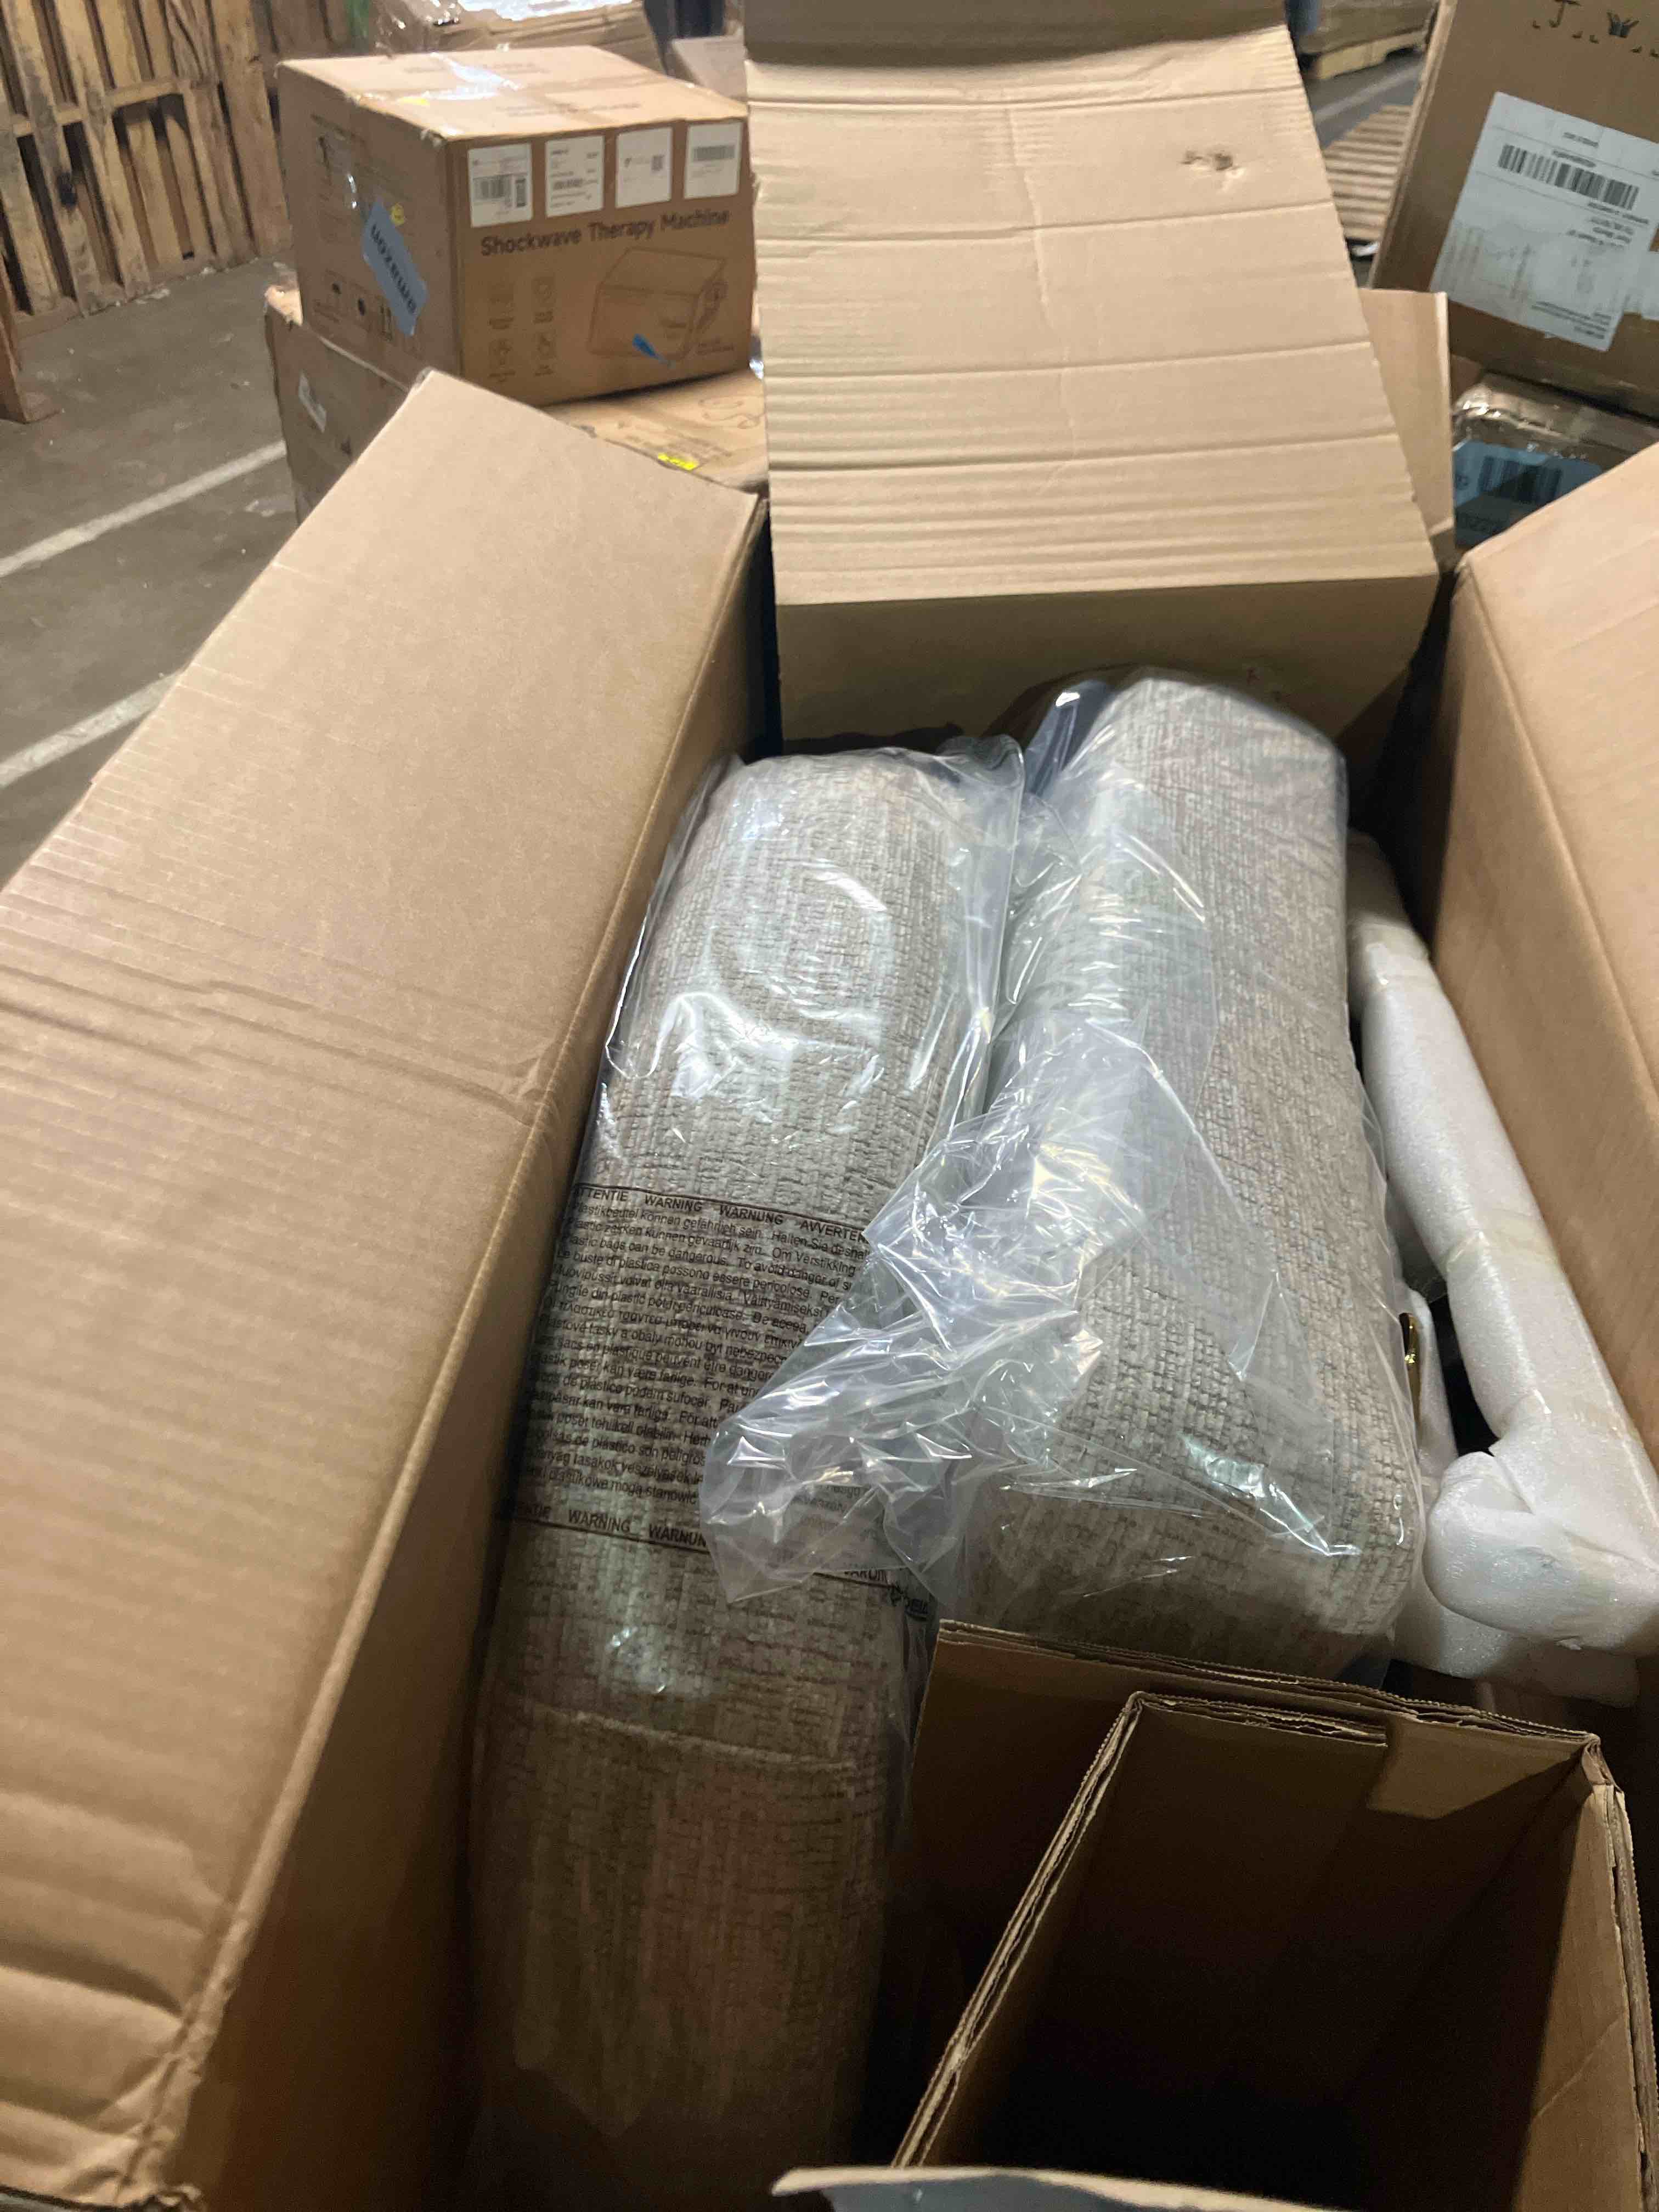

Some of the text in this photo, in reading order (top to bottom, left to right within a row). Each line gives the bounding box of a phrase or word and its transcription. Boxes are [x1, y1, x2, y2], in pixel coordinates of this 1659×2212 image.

[481, 209, 731, 256] Shockwave Therapy Machine
[645, 1194, 702, 1213] WARNING
[719, 1205, 783, 1225] WARNUNG
[600, 1236, 624, 1254] bags
[629, 1242, 648, 1252] can
[652, 1244, 665, 1256] be
[737, 1257, 752, 1269] To
[772, 1246, 792, 1261] Om
[619, 1257, 659, 1273] plastica
[662, 1264, 709, 1281] possono
[713, 1273, 753, 1287] essere
[611, 1290, 645, 1305] plastic
[568, 1508, 631, 1533] WARNING
